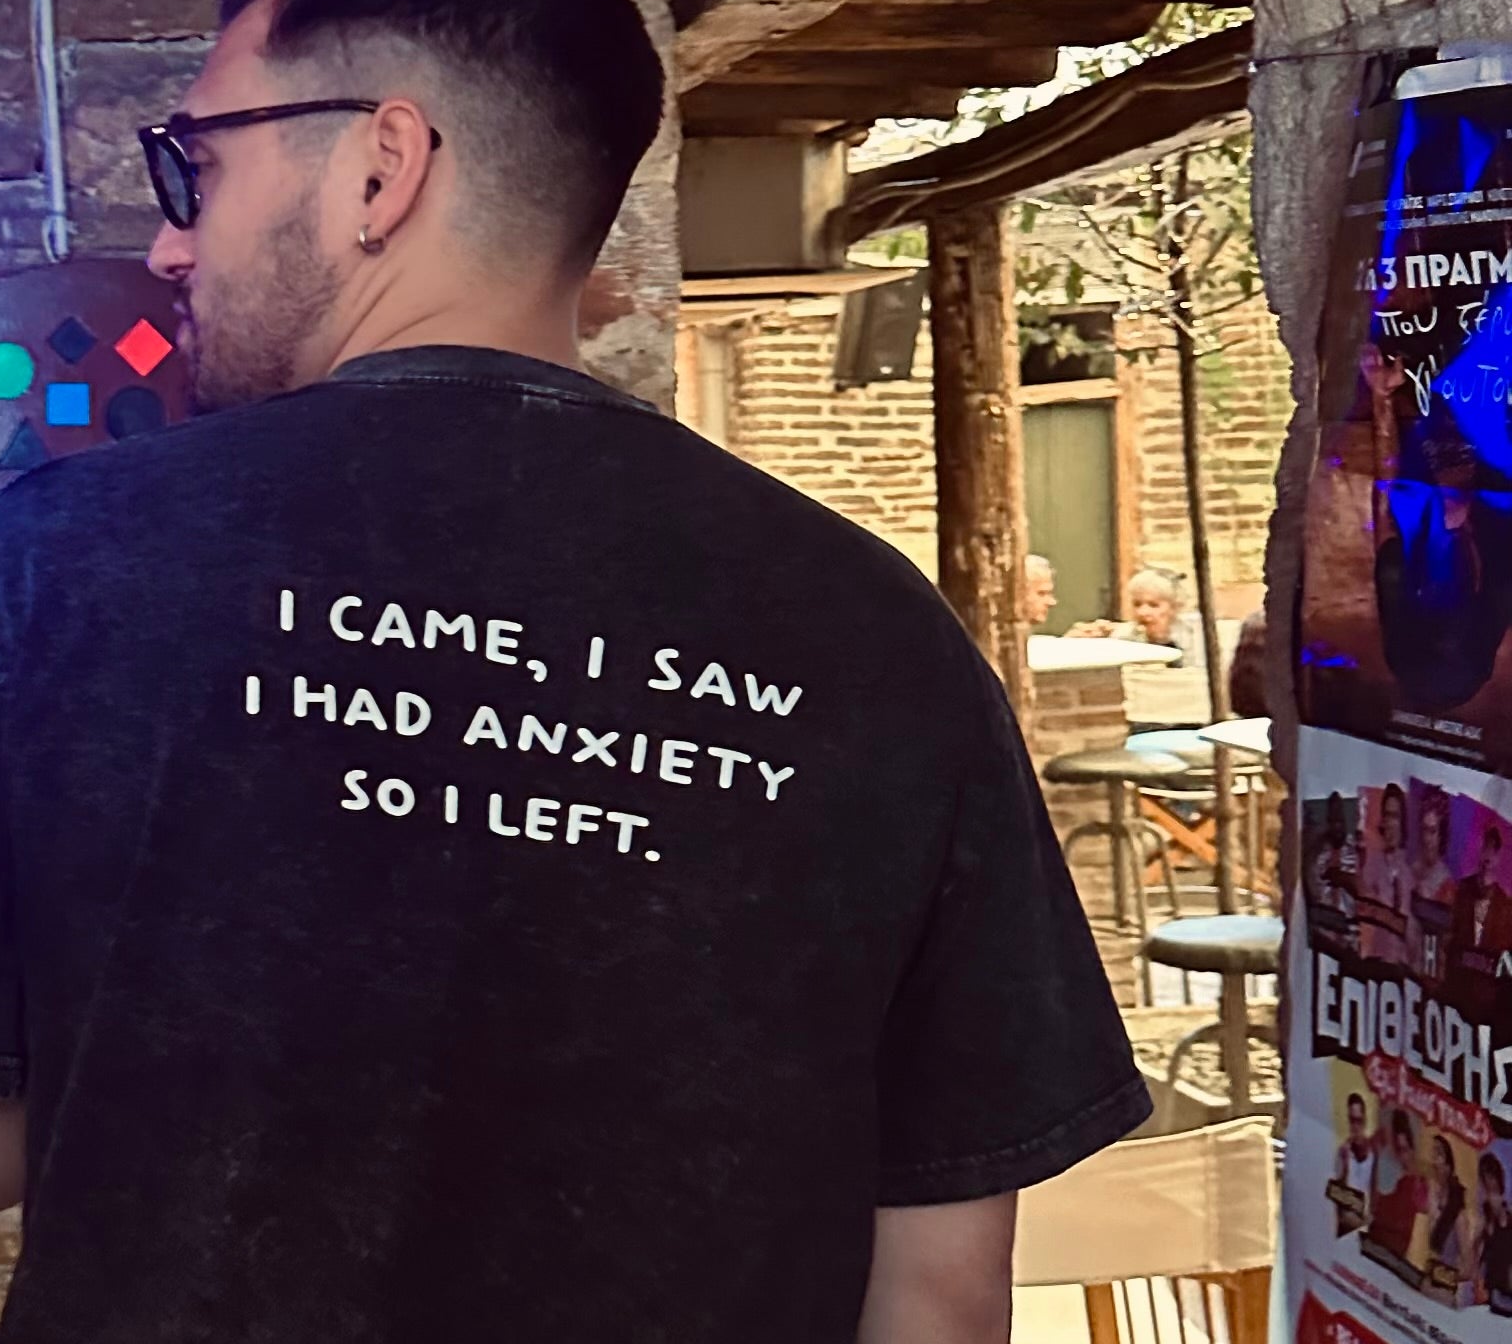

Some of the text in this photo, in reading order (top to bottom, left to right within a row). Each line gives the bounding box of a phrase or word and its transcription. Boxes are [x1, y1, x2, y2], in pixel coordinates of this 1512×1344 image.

[1405, 247, 1512, 289] ΠΡΑΓΜ
[279, 589, 803, 717] I CAME, I SAW
[245, 675, 795, 801] I HAD ANXIETY
[340, 769, 661, 862] SO I LEFT.
